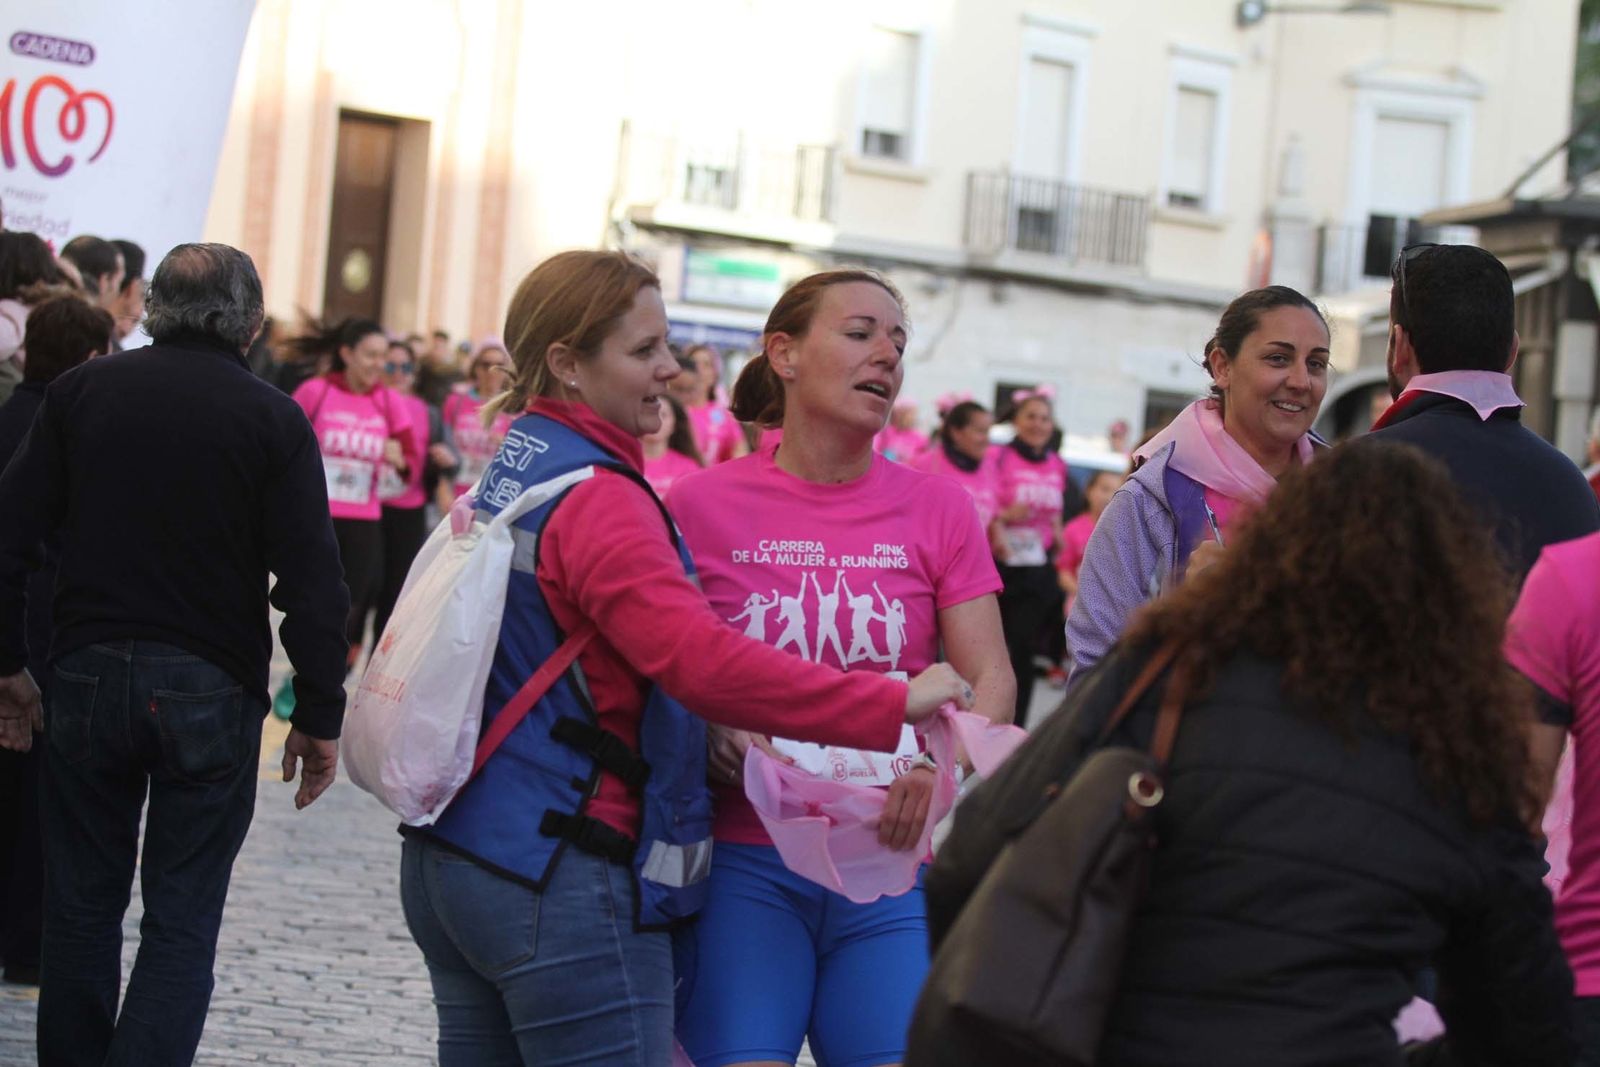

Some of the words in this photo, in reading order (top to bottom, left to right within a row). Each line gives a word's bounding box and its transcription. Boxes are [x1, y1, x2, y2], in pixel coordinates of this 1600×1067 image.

[12, 33, 92, 64] CADENA
[759, 540, 825, 554] CARRERA
[873, 543, 907, 557] PINK
[732, 550, 749, 563] DE
[753, 551, 771, 564] LA
[775, 552, 825, 567] MUJER
[829, 556, 838, 568] &
[841, 556, 909, 569] RUNNING
